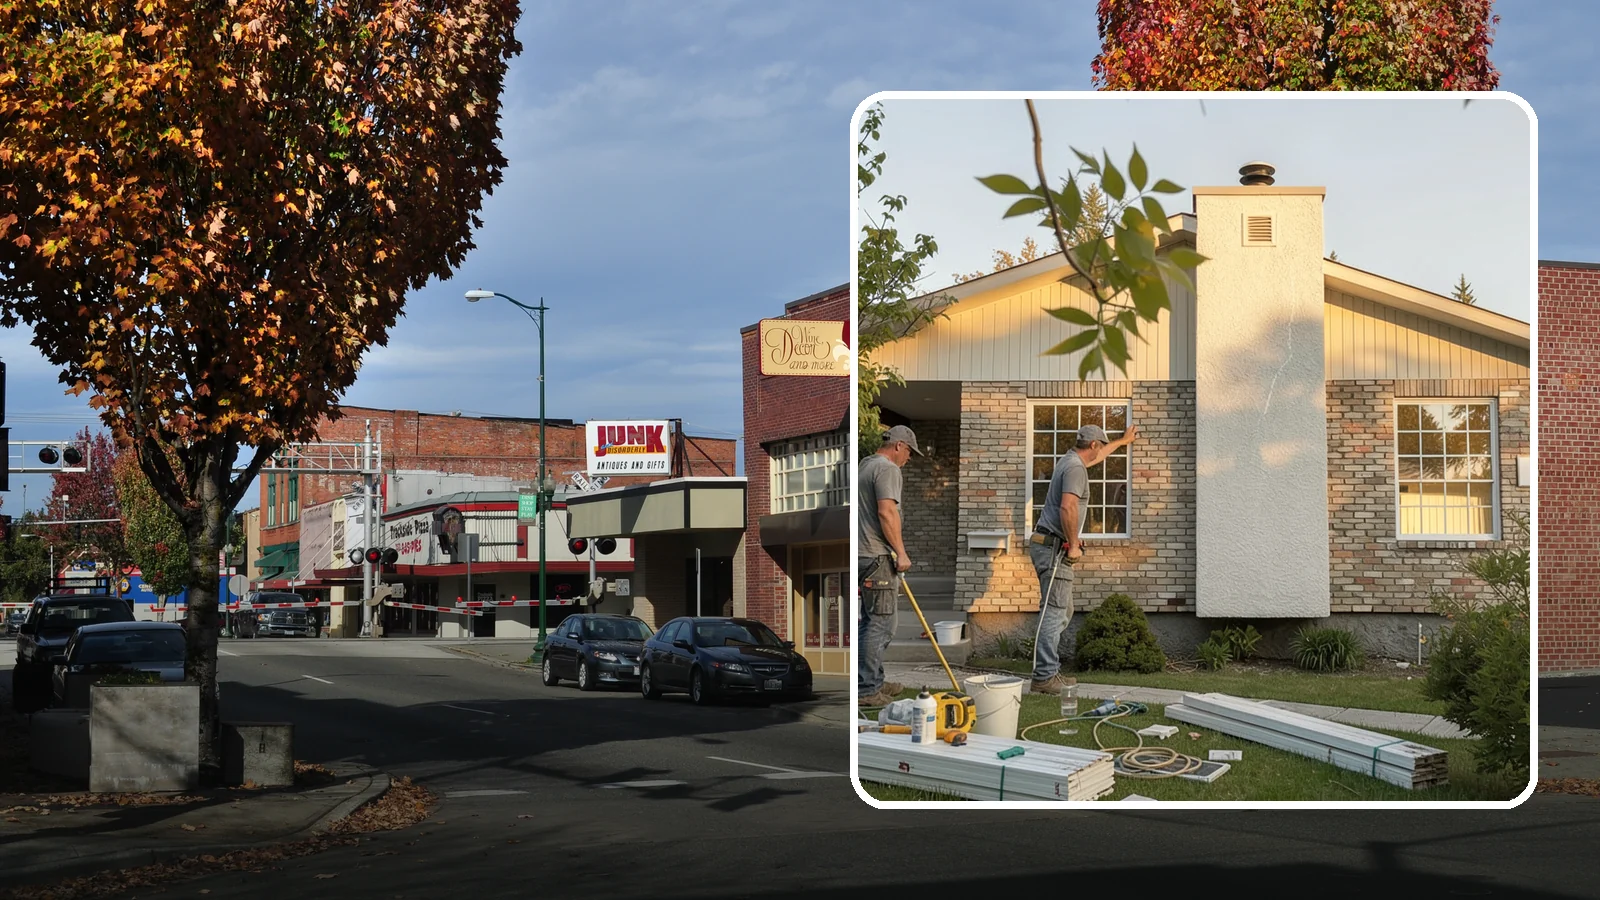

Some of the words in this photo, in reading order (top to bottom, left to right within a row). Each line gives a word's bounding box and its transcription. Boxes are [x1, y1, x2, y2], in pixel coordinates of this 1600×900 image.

[596, 426, 665, 457] JUNK
[597, 462, 628, 470] ANTIQUES
[631, 461, 644, 469] AND
[647, 461, 665, 469] GIFTS
